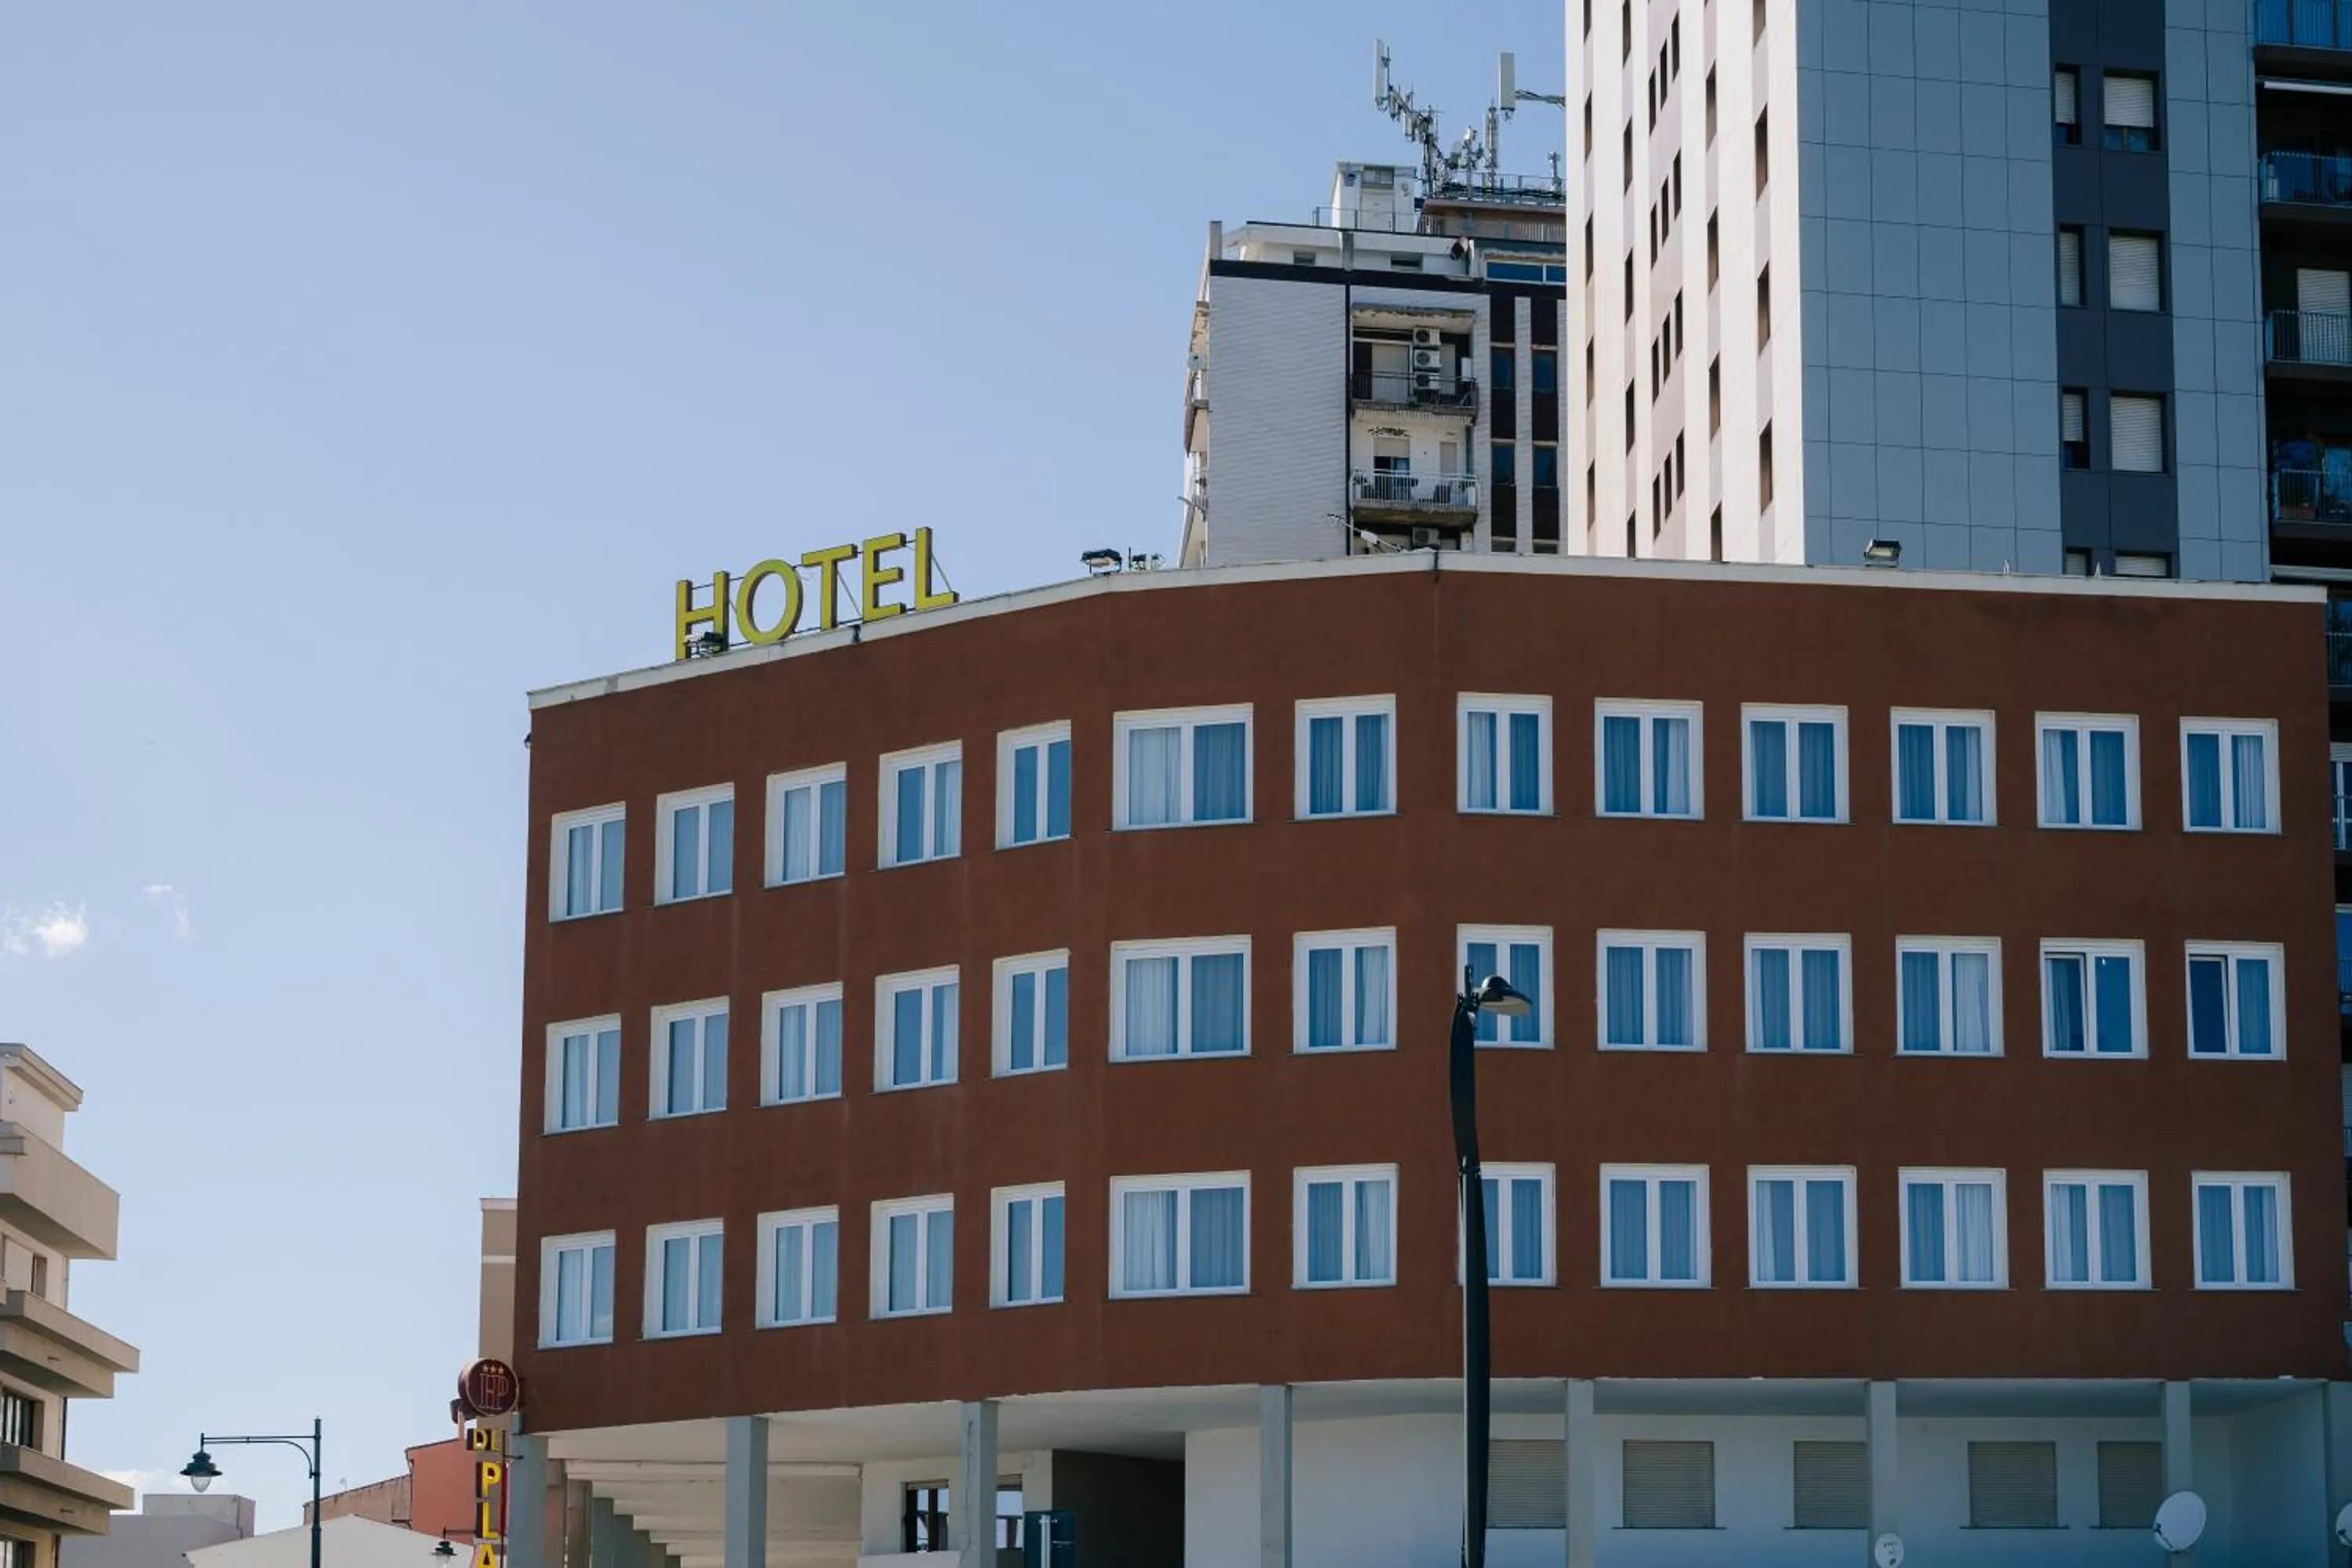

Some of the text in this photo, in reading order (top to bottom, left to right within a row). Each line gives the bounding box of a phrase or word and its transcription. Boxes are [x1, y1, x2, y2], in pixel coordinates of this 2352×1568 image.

[676, 527, 959, 662] HOTEL
[472, 1428, 501, 1451] DE
[477, 1461, 503, 1568] PLA
